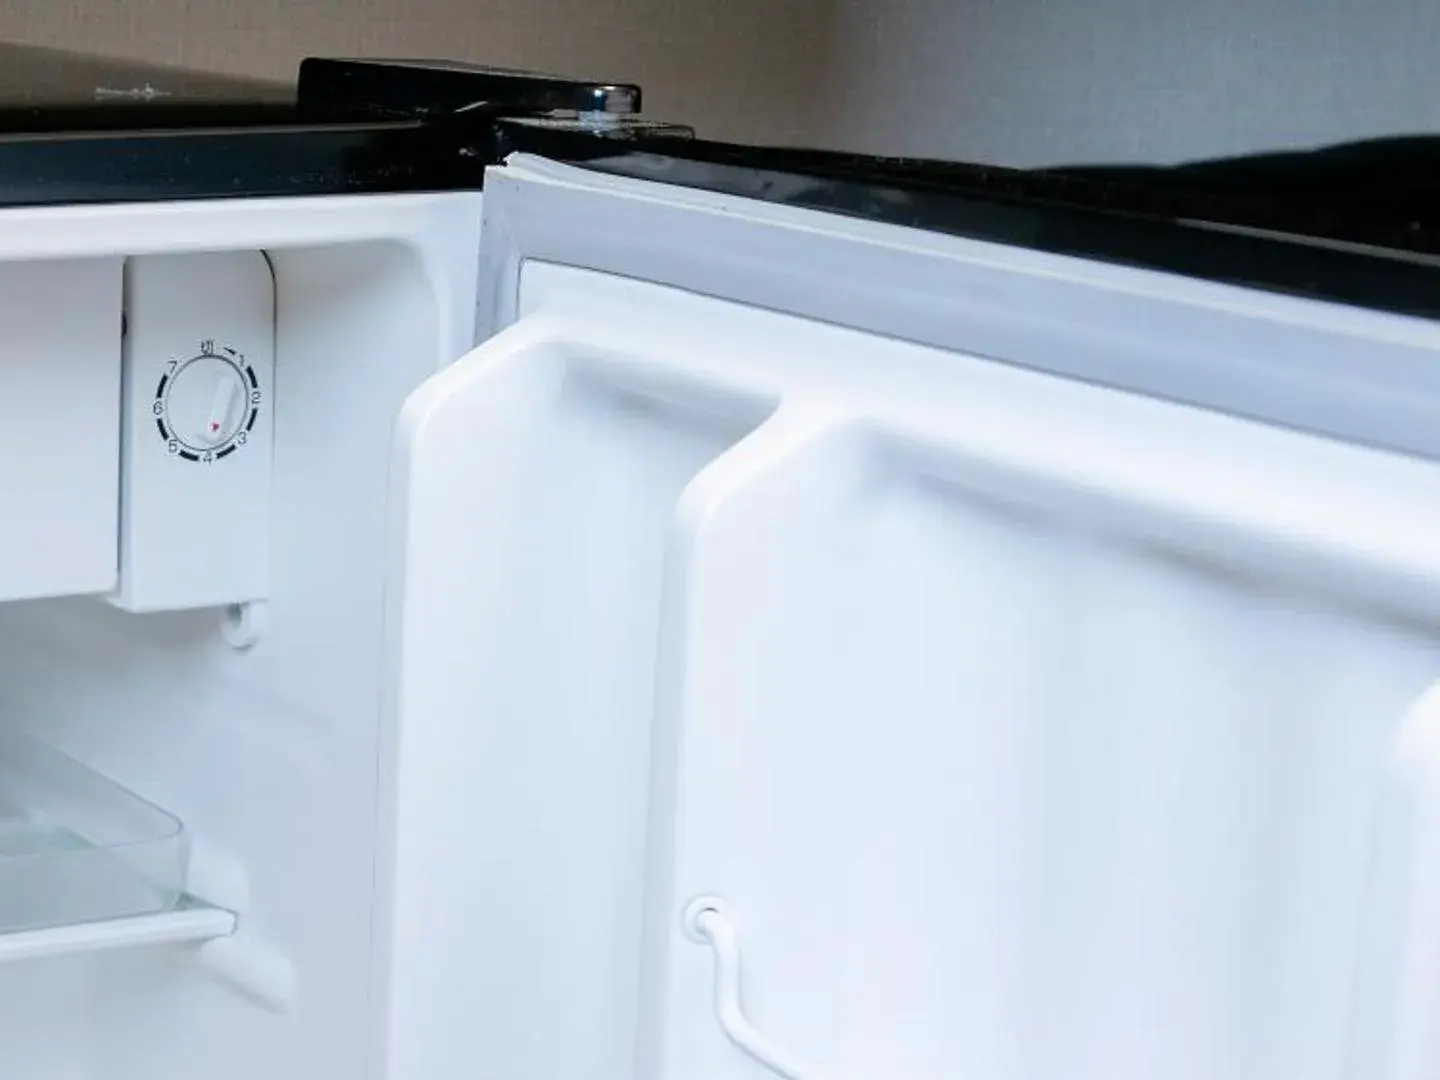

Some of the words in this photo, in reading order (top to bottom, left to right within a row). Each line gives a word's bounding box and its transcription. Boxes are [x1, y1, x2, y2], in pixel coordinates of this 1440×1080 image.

[169, 361, 177, 373] 7
[252, 391, 261, 404] 2
[153, 401, 163, 415] 6
[237, 432, 246, 444] 3
[169, 441, 178, 453] 5
[203, 453, 212, 465] 4
